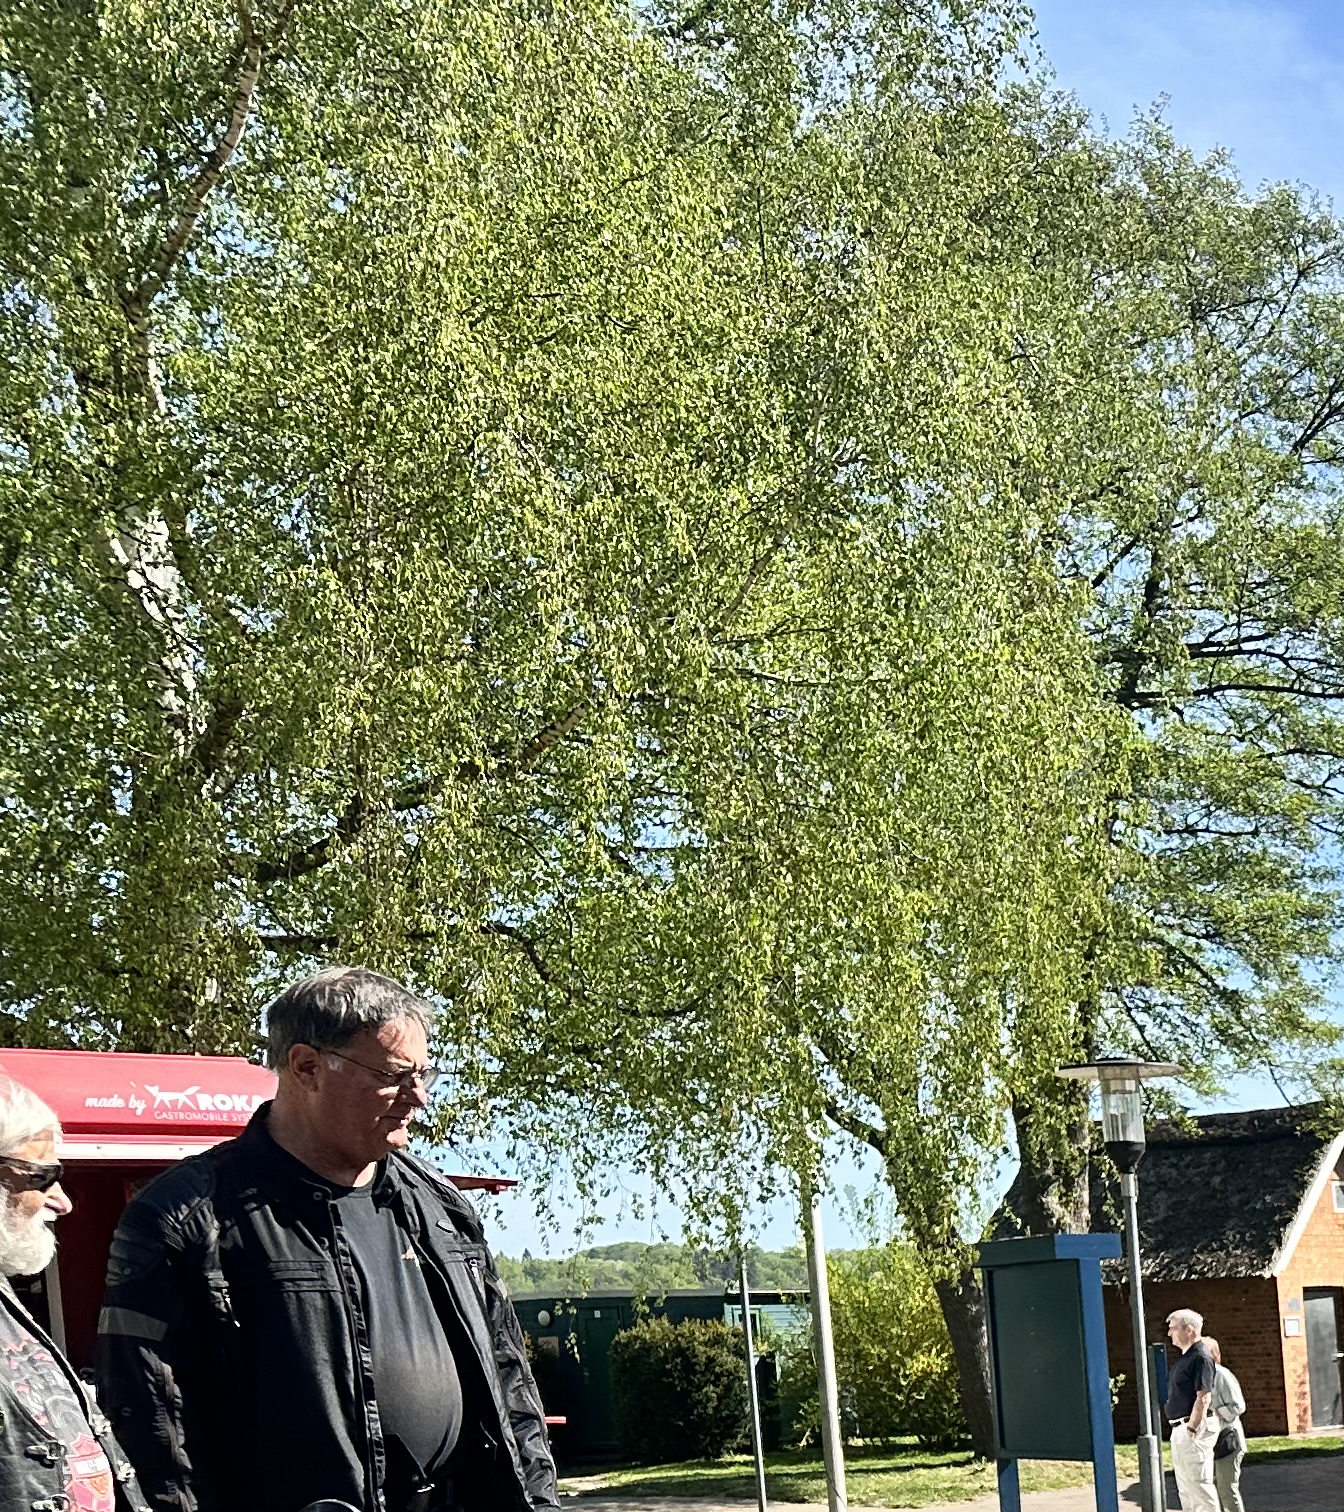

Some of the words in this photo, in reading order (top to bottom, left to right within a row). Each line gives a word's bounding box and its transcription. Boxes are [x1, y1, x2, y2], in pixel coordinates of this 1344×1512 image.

[84, 1094, 126, 1108] made
[128, 1093, 147, 1116] by
[153, 1111, 228, 1122] GASTROMOBILE
